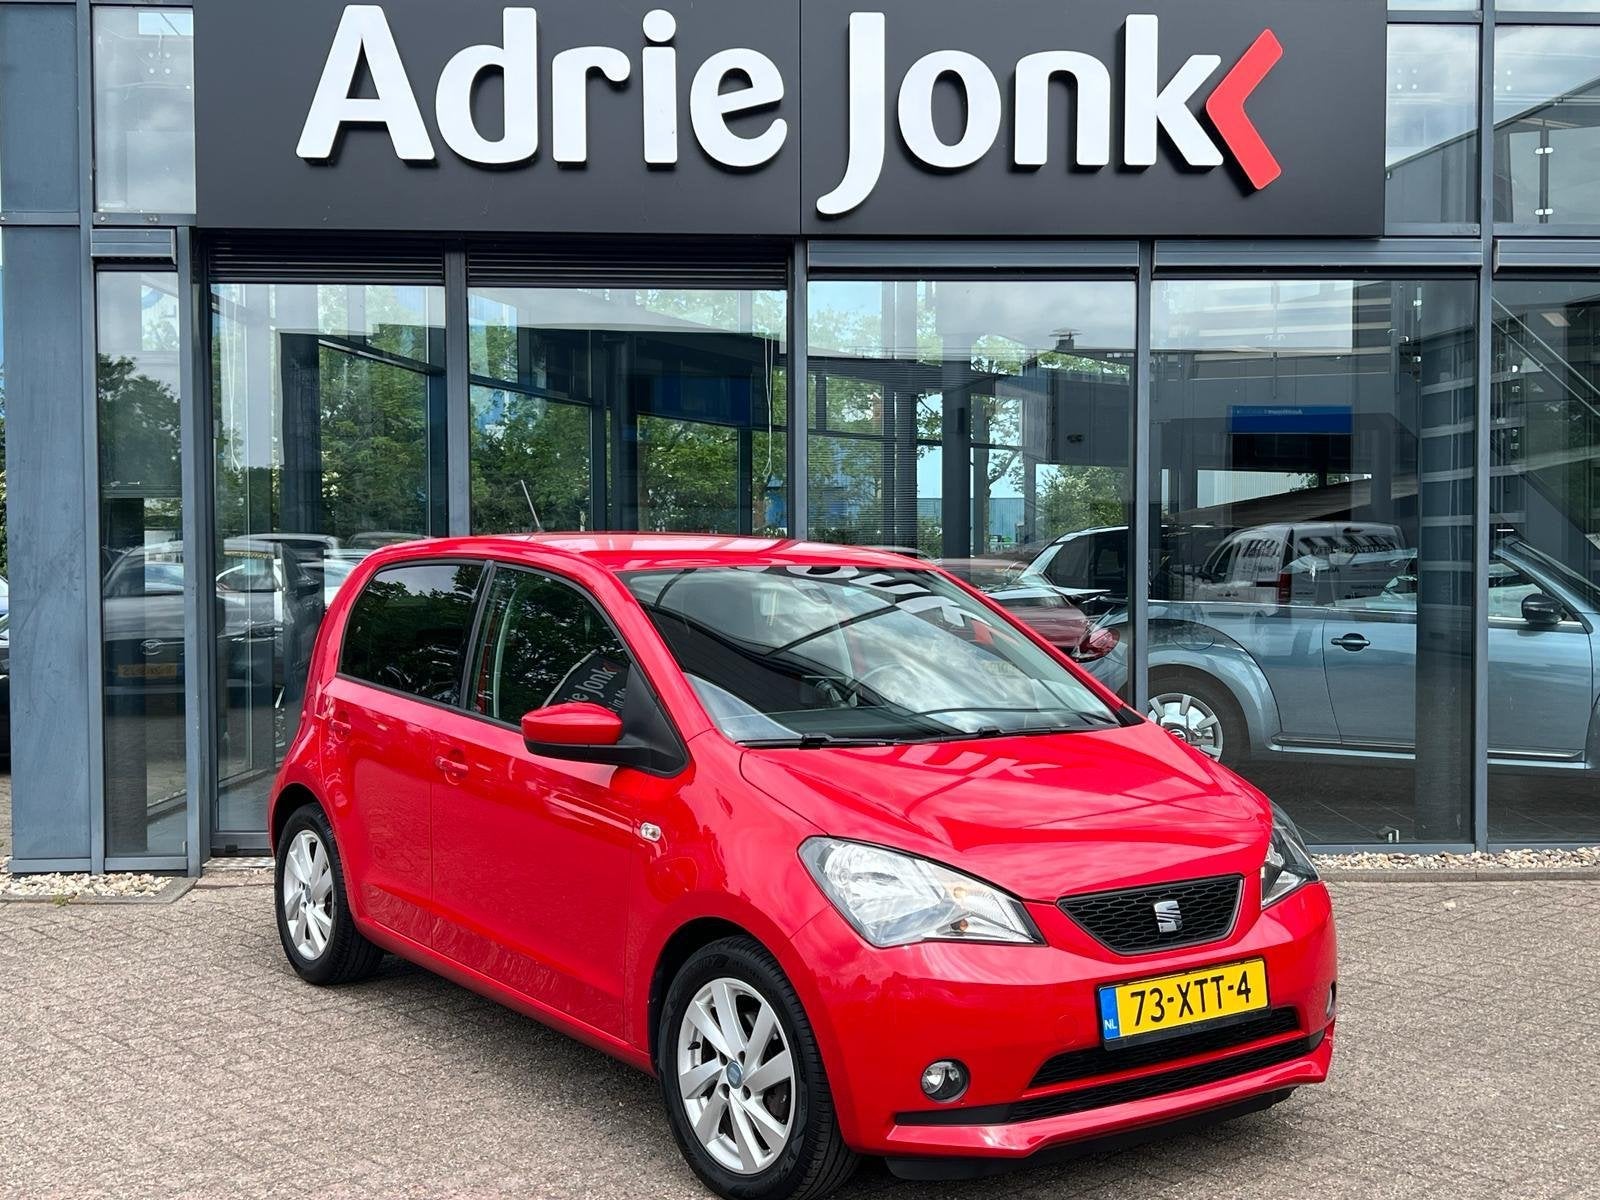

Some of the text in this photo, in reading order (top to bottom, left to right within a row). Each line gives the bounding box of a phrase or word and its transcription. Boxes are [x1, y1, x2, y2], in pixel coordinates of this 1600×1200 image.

[296, 4, 1224, 215] Adrie Jonk
[575, 667, 617, 698] Jonk
[1130, 970, 1252, 1027] 73-XTT-4
[1104, 1019, 1118, 1030] NL
